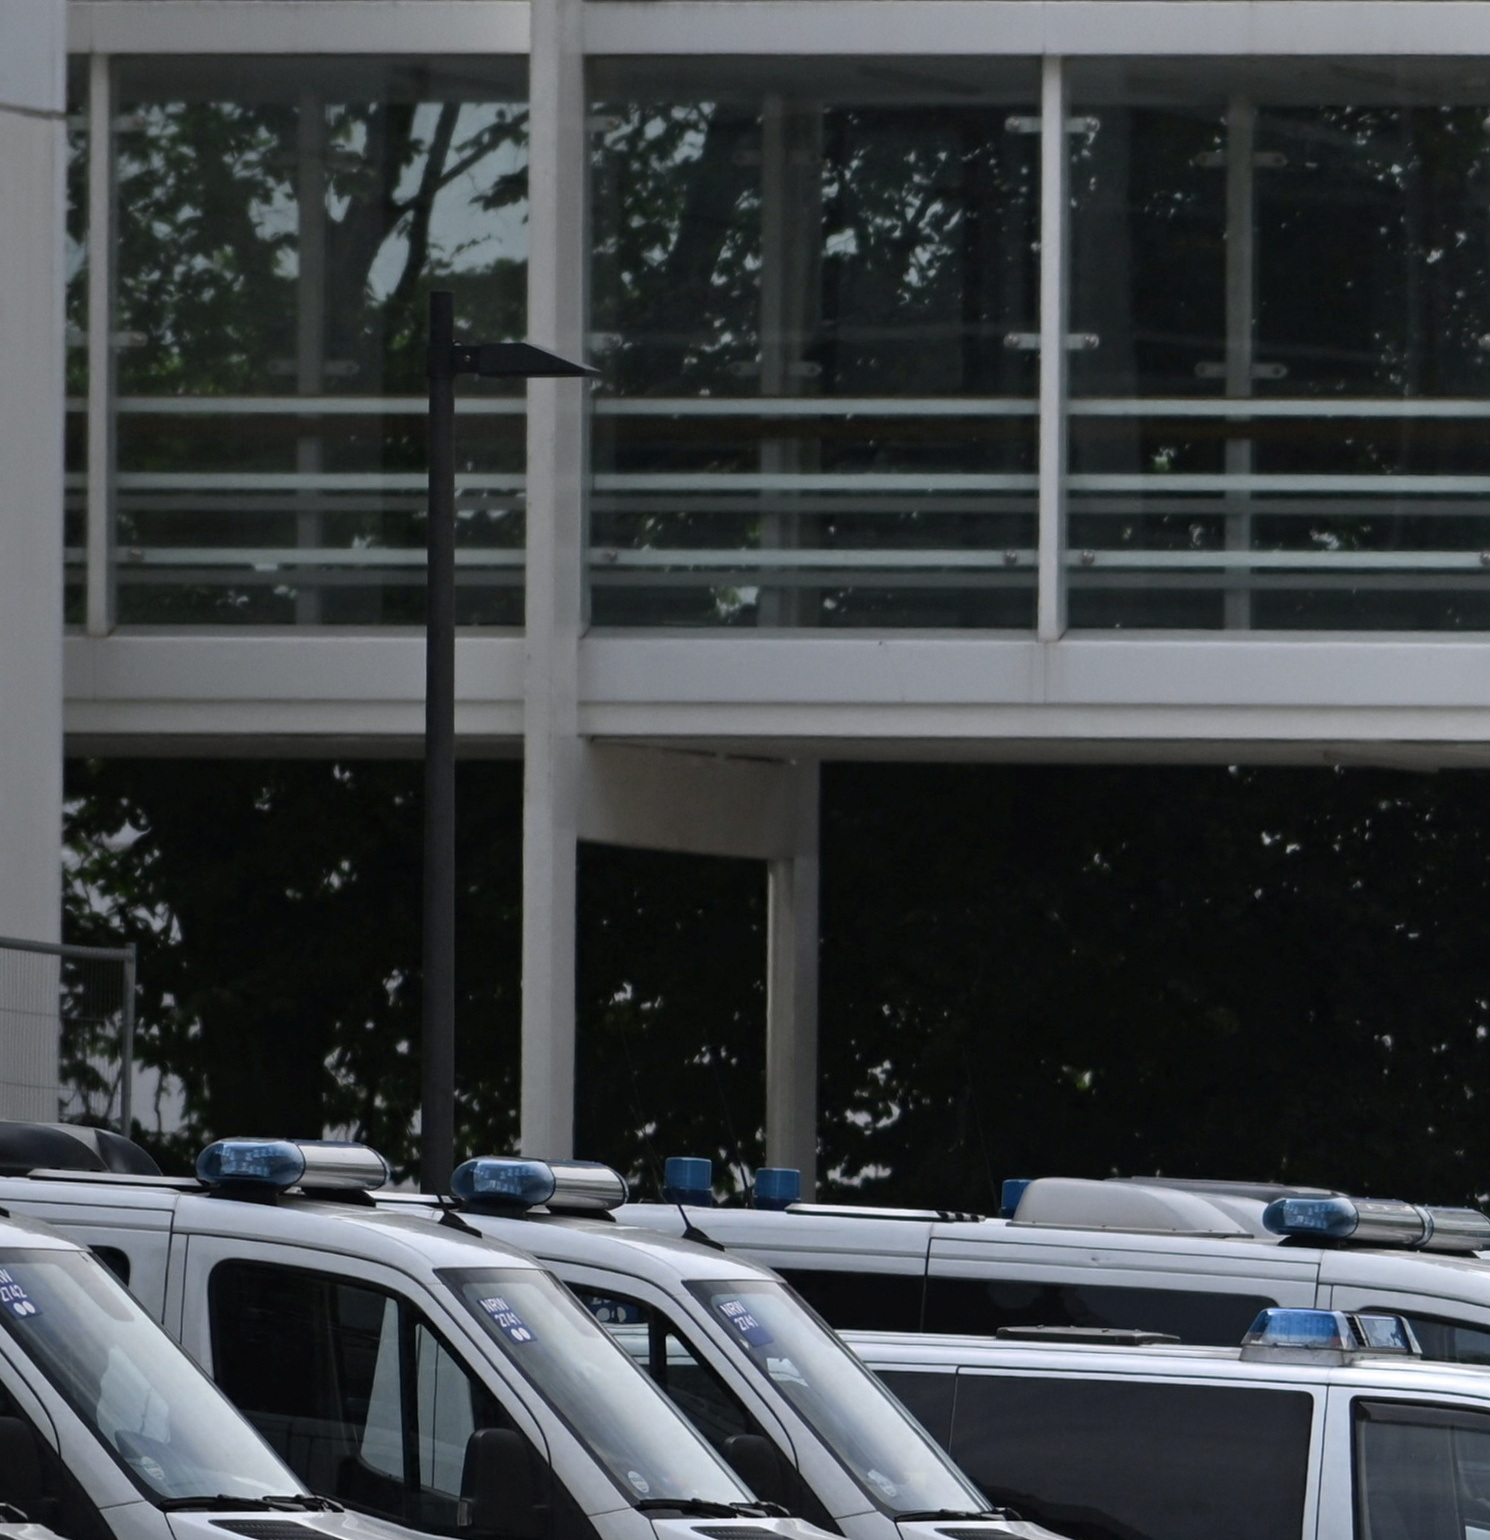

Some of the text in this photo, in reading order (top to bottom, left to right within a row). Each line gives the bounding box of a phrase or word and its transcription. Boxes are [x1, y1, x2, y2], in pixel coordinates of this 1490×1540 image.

[480, 1297, 510, 1313] NRW
[720, 1300, 747, 1318] NRW
[494, 1311, 522, 1328] 2741
